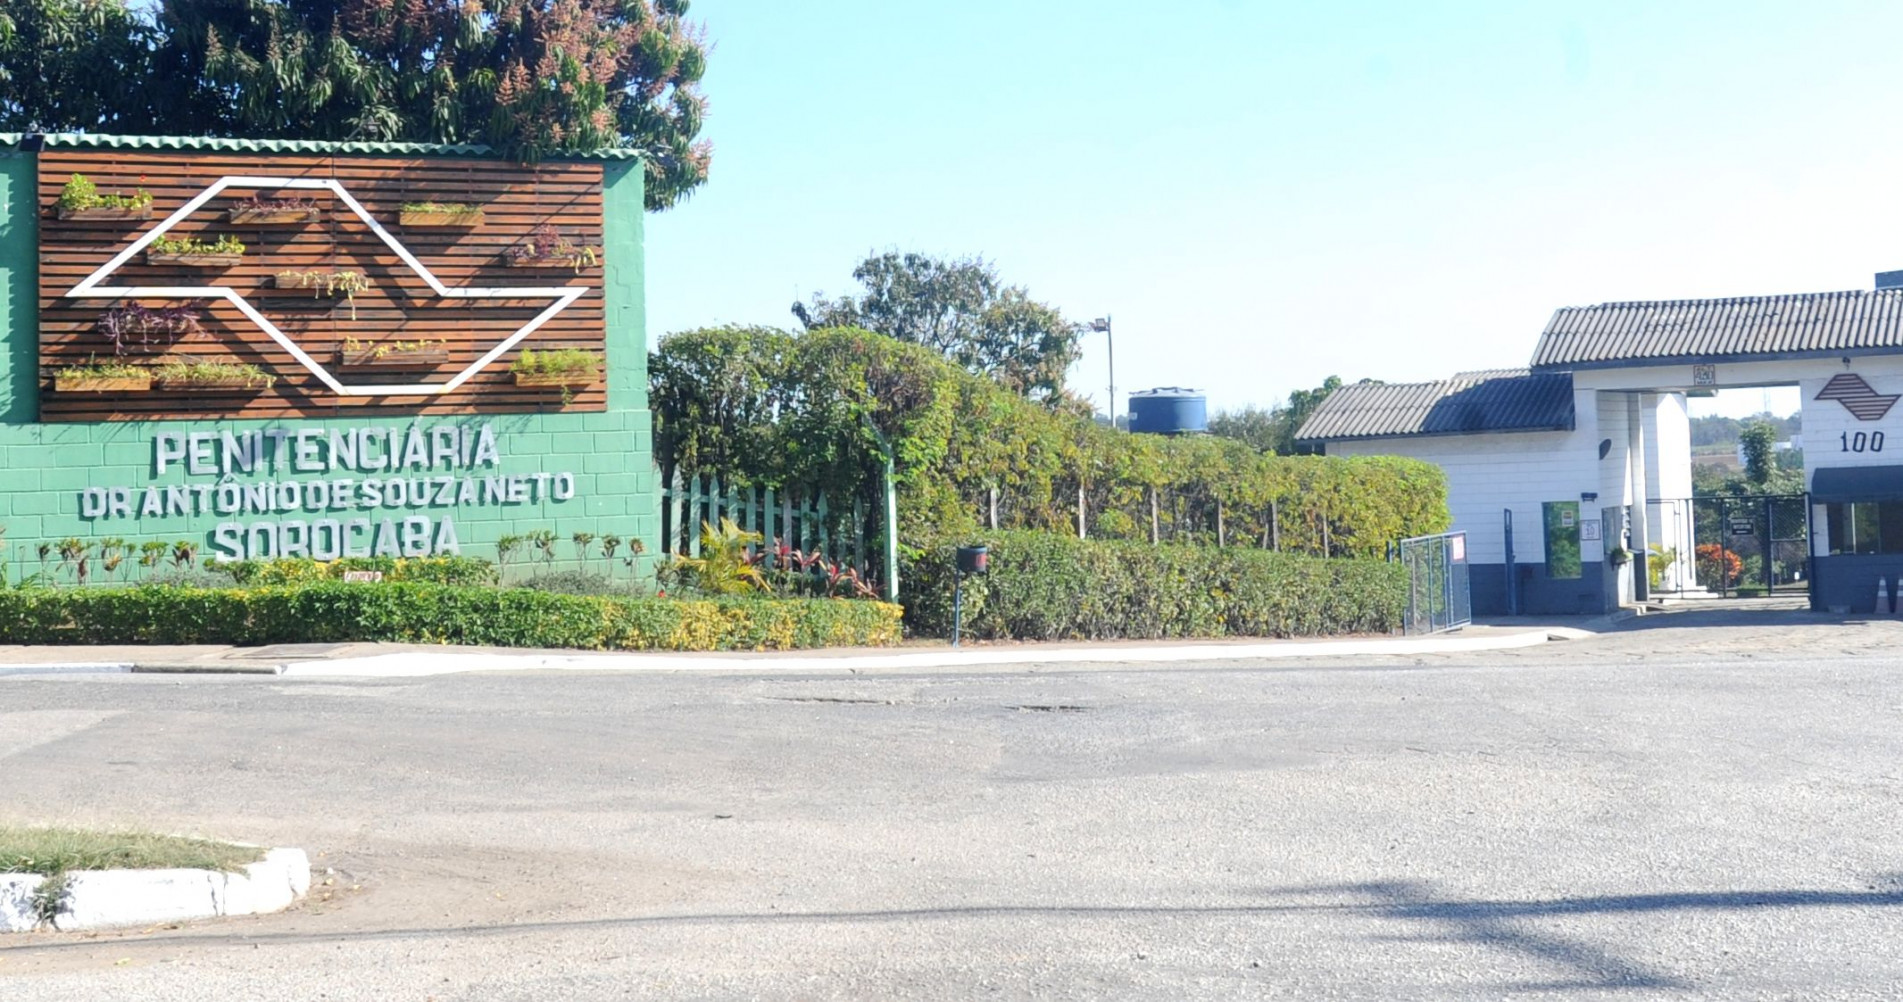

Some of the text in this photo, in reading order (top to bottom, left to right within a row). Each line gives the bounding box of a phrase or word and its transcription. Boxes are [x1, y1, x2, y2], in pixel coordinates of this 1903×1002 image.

[156, 415, 500, 475] PENITENCIÁRIA
[1840, 431, 1884, 453] 100
[82, 472, 575, 517] DR ANTÔNIO DE SOUZA NETO
[215, 515, 461, 563] SOROCABA
